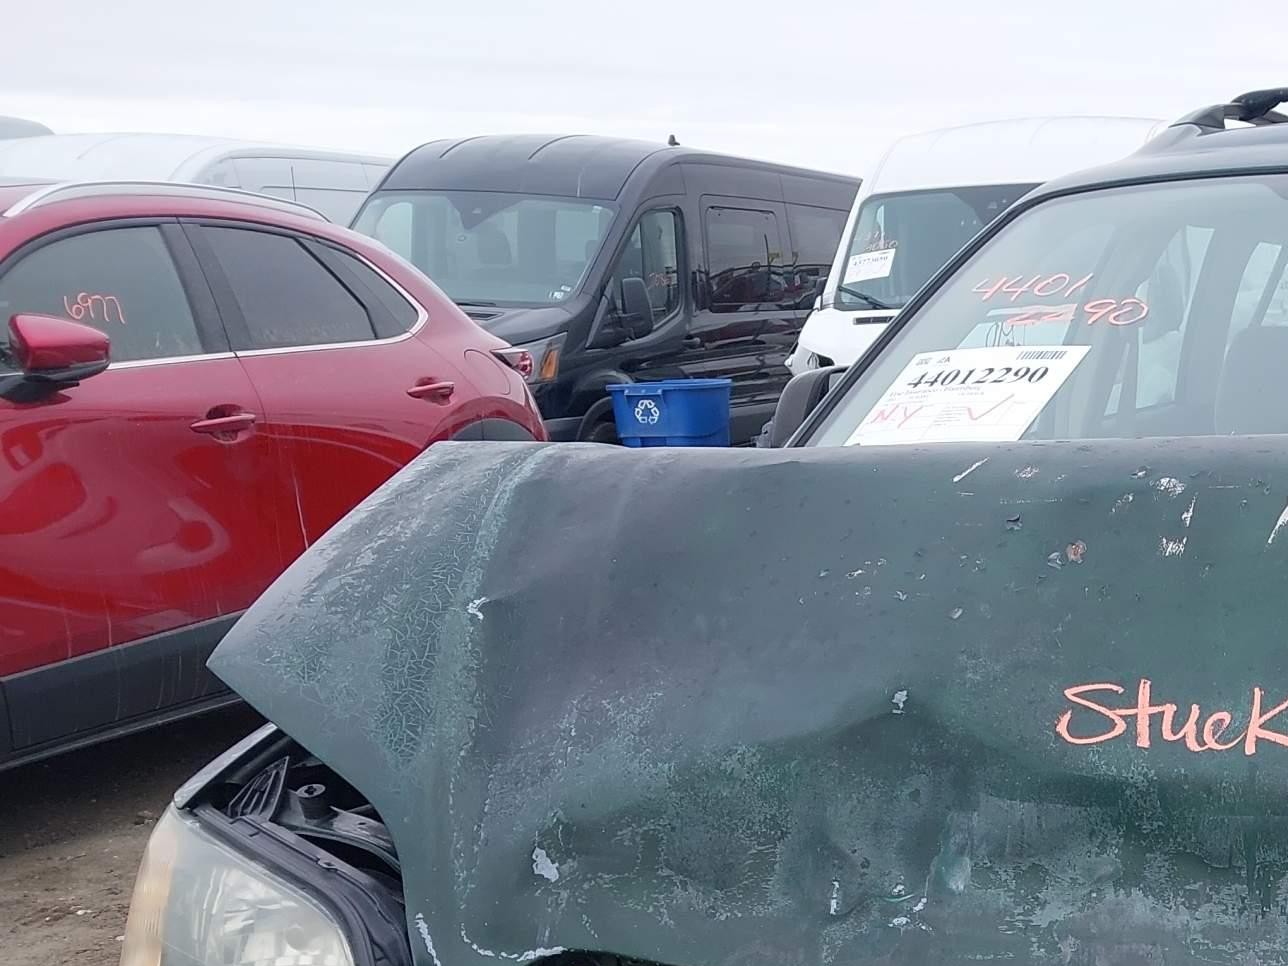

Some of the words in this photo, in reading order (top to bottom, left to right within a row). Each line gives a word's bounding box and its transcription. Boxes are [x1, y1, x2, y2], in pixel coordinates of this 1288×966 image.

[971, 272, 1094, 301] 4401
[63, 291, 126, 325] 6977
[906, 366, 1050, 390] 44012290
